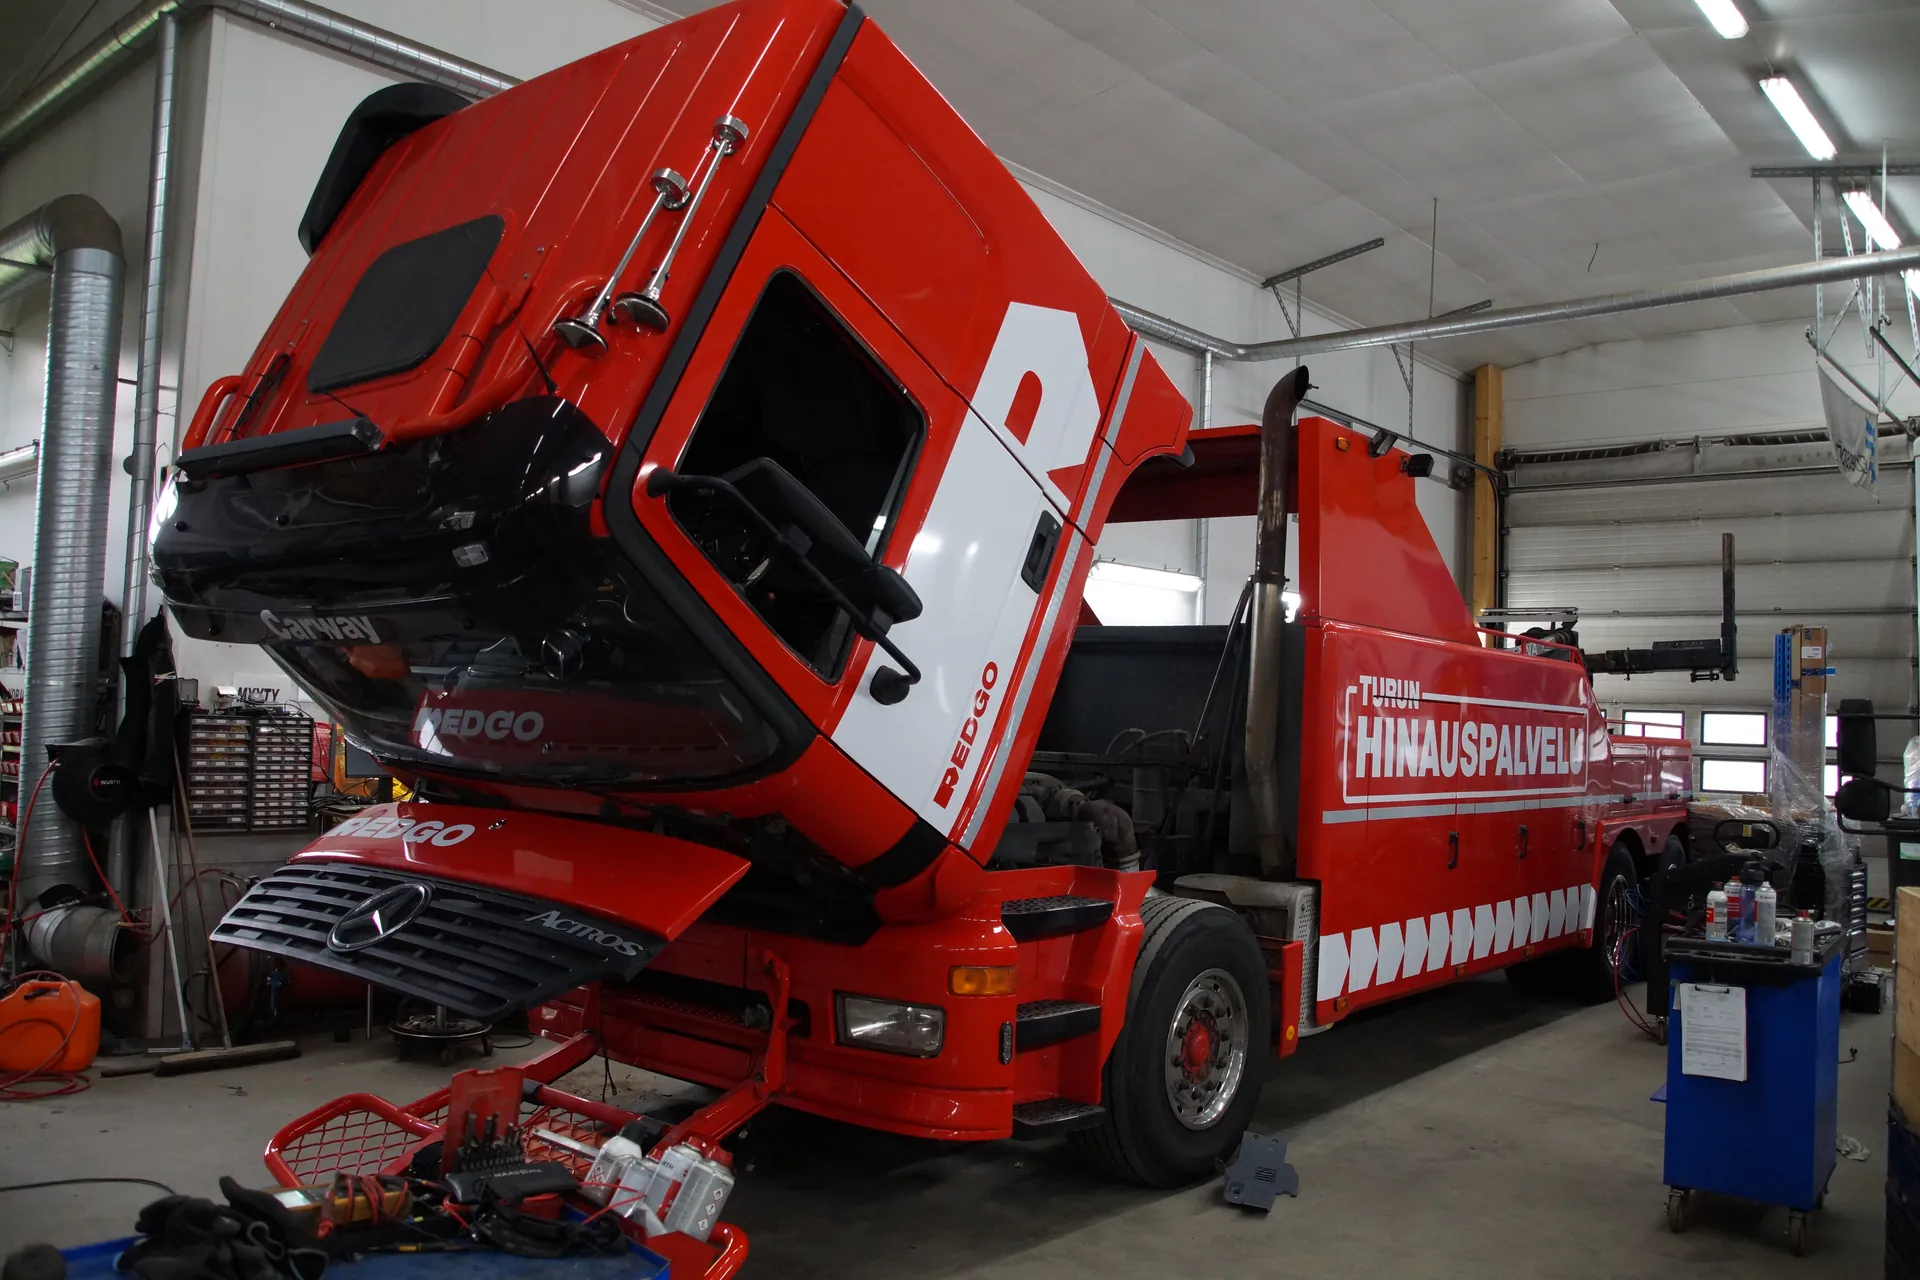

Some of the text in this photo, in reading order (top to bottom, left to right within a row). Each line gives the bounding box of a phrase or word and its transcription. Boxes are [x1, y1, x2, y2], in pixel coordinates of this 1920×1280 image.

[260, 609, 381, 644] Carway
[1359, 675, 1420, 709] TURUN
[933, 661, 998, 809] REDGO
[1355, 715, 1584, 778] HINAUSPALVELU
[322, 816, 476, 847] REDGO
